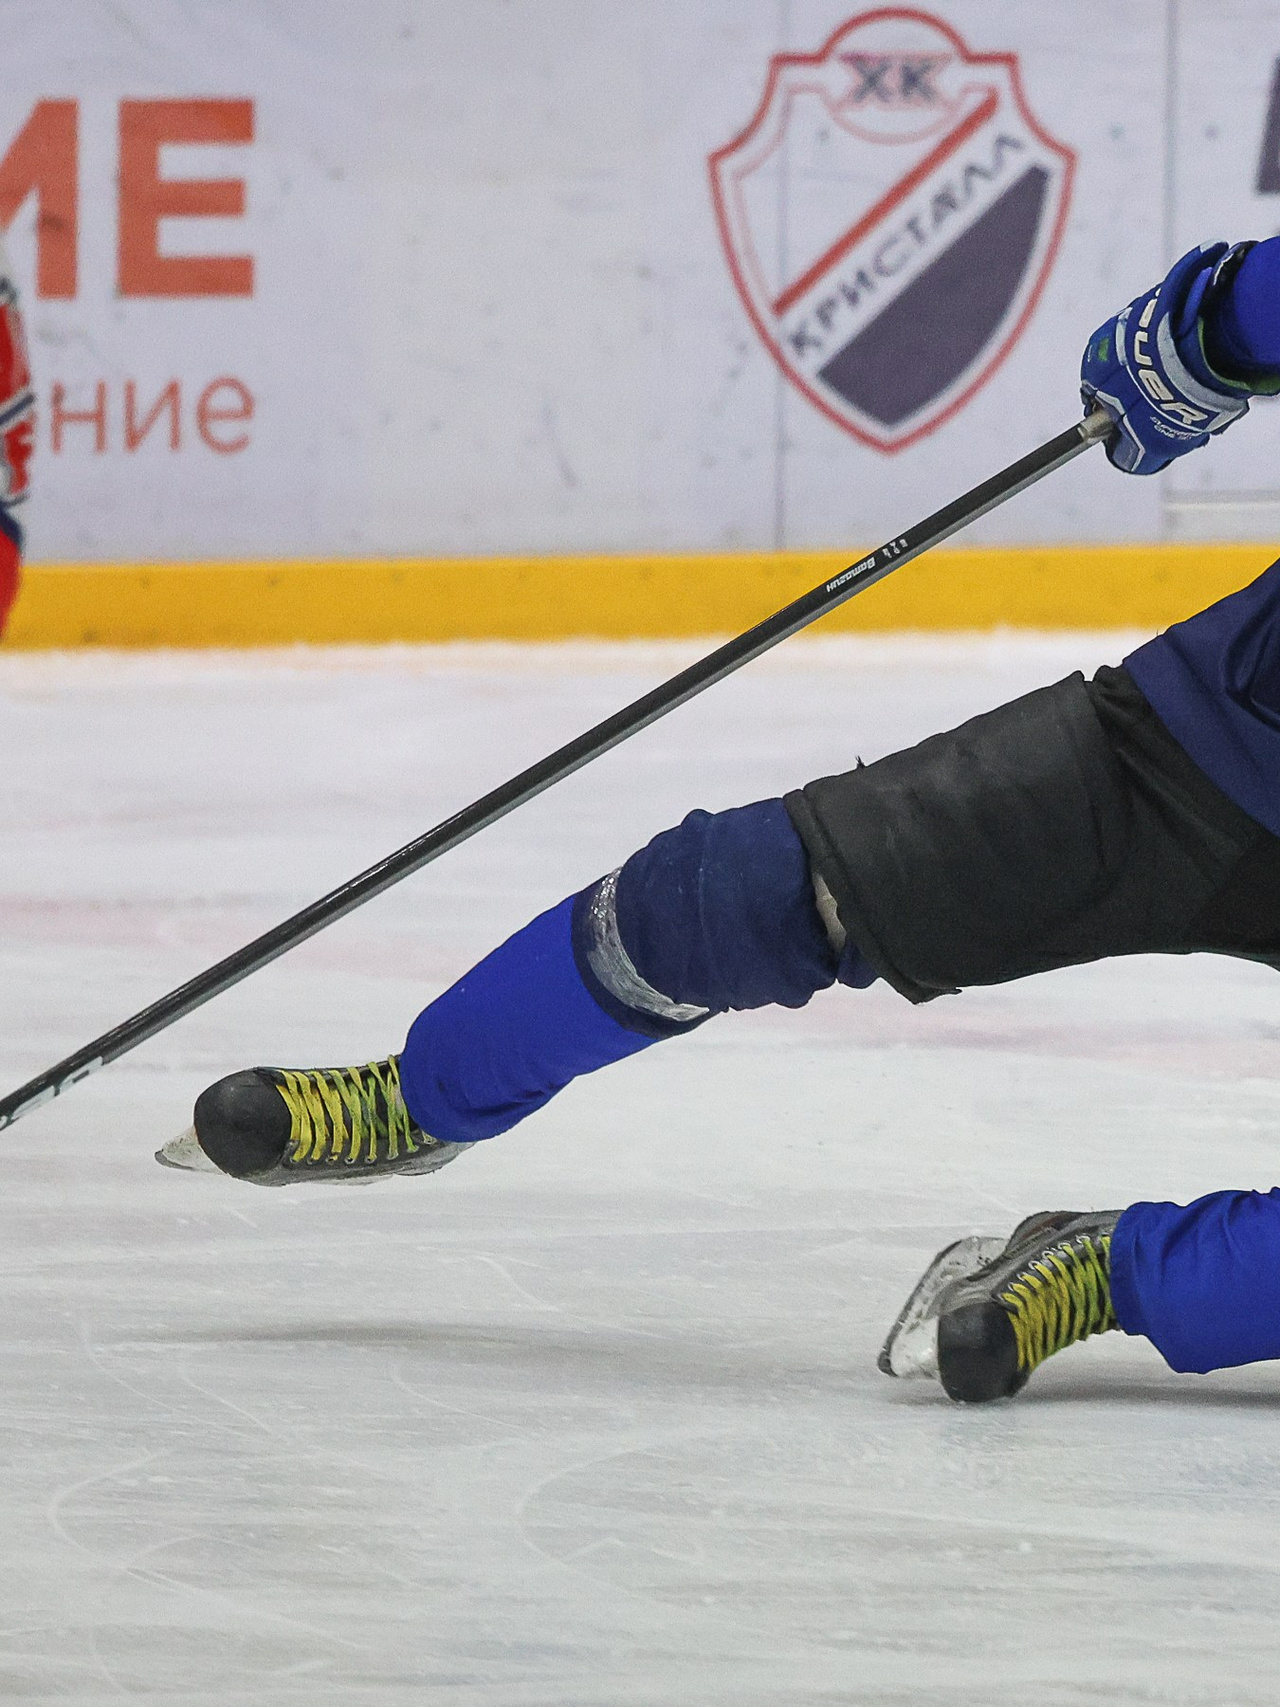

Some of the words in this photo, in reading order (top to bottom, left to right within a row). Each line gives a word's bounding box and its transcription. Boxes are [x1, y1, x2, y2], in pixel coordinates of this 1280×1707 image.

[847, 58, 940, 102] ХК
[786, 133, 1024, 358] КРИСТАЛЛ
[1133, 287, 1209, 425] UER
